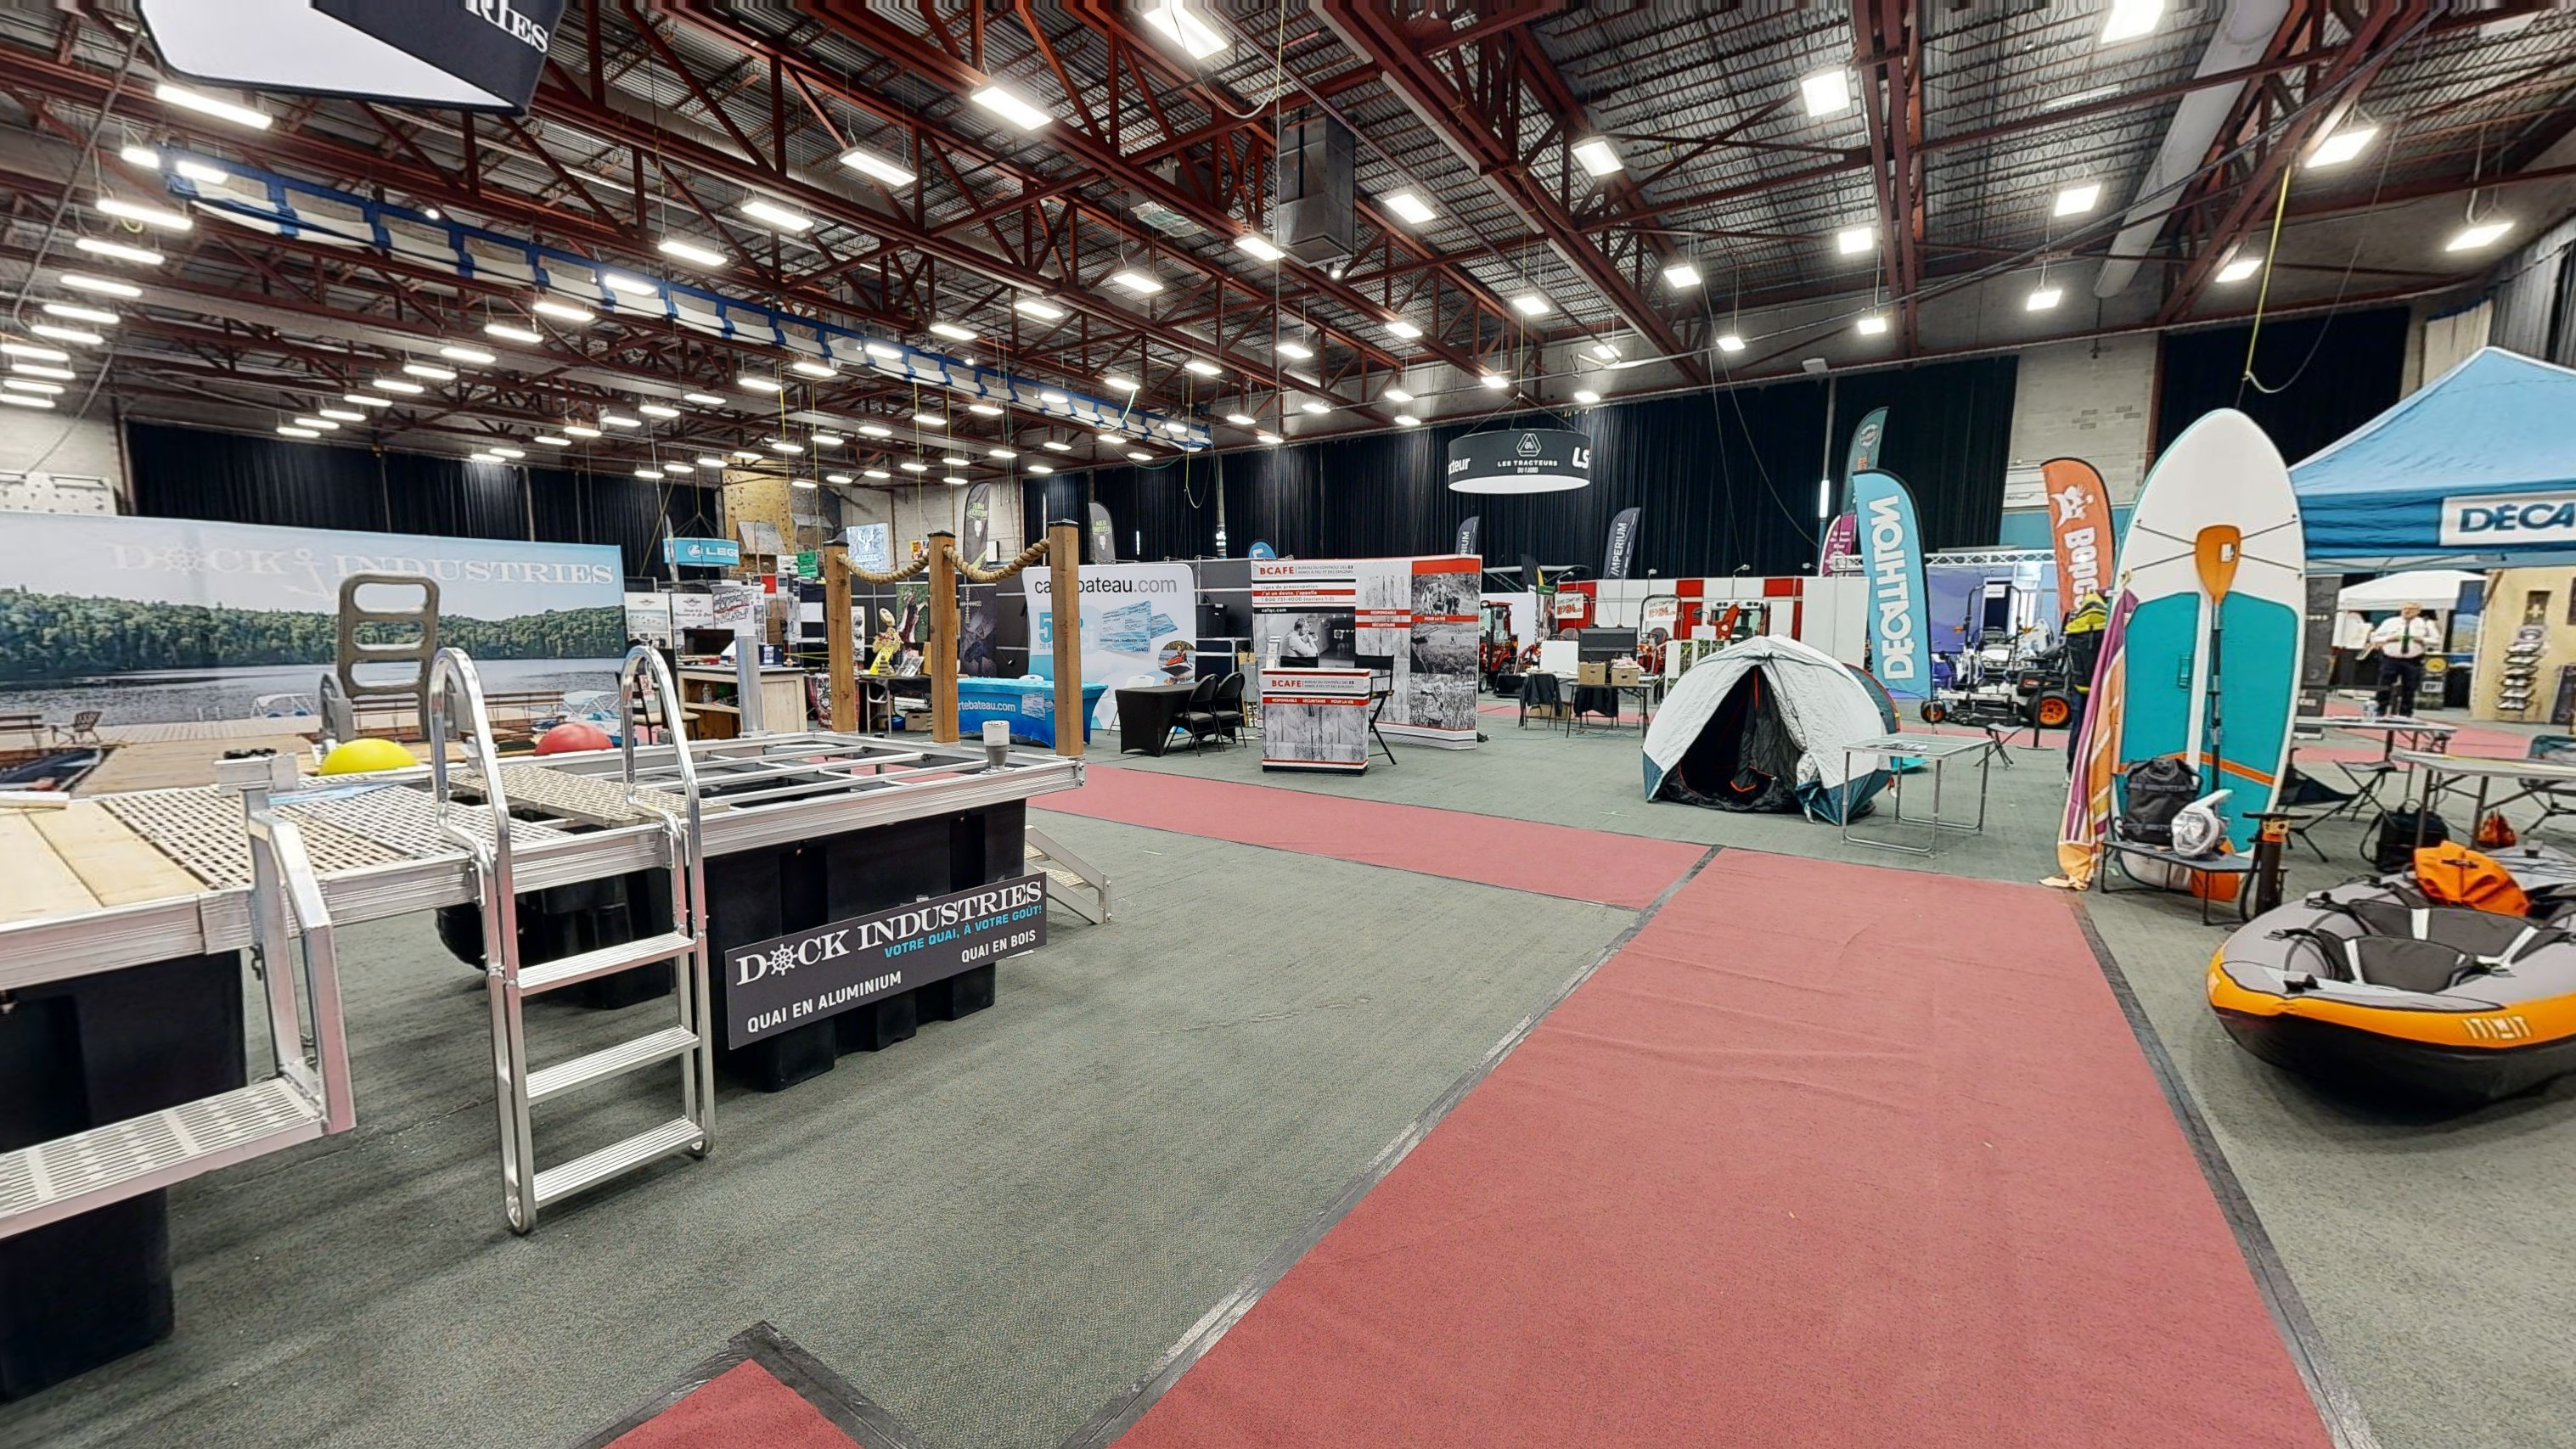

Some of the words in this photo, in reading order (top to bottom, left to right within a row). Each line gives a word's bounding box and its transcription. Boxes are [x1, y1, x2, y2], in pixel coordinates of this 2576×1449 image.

[1460, 531, 1471, 555] RIUM
[333, 554, 614, 584] INDUSTRIES
[1260, 566, 1295, 575] BCAFE
[1035, 577, 1177, 593] cabateau.com
[958, 700, 1016, 712] rtebateau.com
[858, 881, 1042, 951] INDUSTRIES
[884, 936, 924, 958] VOTRE
[928, 928, 960, 949] QUAI,
[964, 920, 972, 935] À
[975, 913, 1009, 933] VOTRE
[1012, 904, 1043, 922] GOÛT!
[961, 943, 989, 963] QUAI
[993, 939, 1008, 954] EN
[1010, 929, 1036, 951] BOIS
[747, 1007, 787, 1034] QUAI
[792, 997, 813, 1018] EN
[818, 970, 902, 1008] ALUMINIUM
